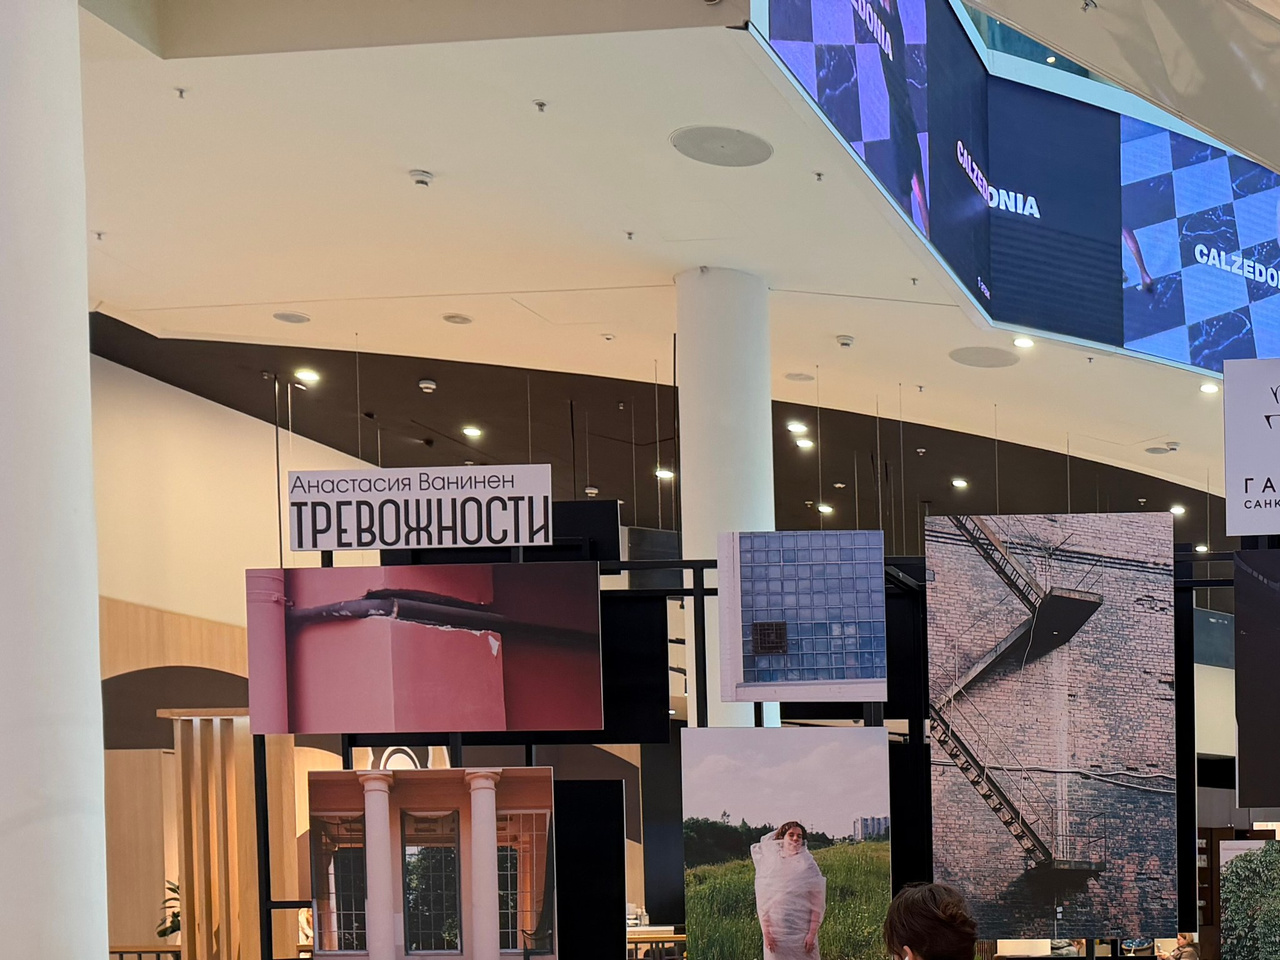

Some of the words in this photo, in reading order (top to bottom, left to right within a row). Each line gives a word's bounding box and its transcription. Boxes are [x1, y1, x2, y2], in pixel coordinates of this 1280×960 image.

[956, 140, 1041, 219] CALZEDONIA
[290, 475, 412, 494] Анастасия
[419, 472, 515, 491] Ванинен
[290, 495, 550, 549] ТРЕВОЖНОСТИ
